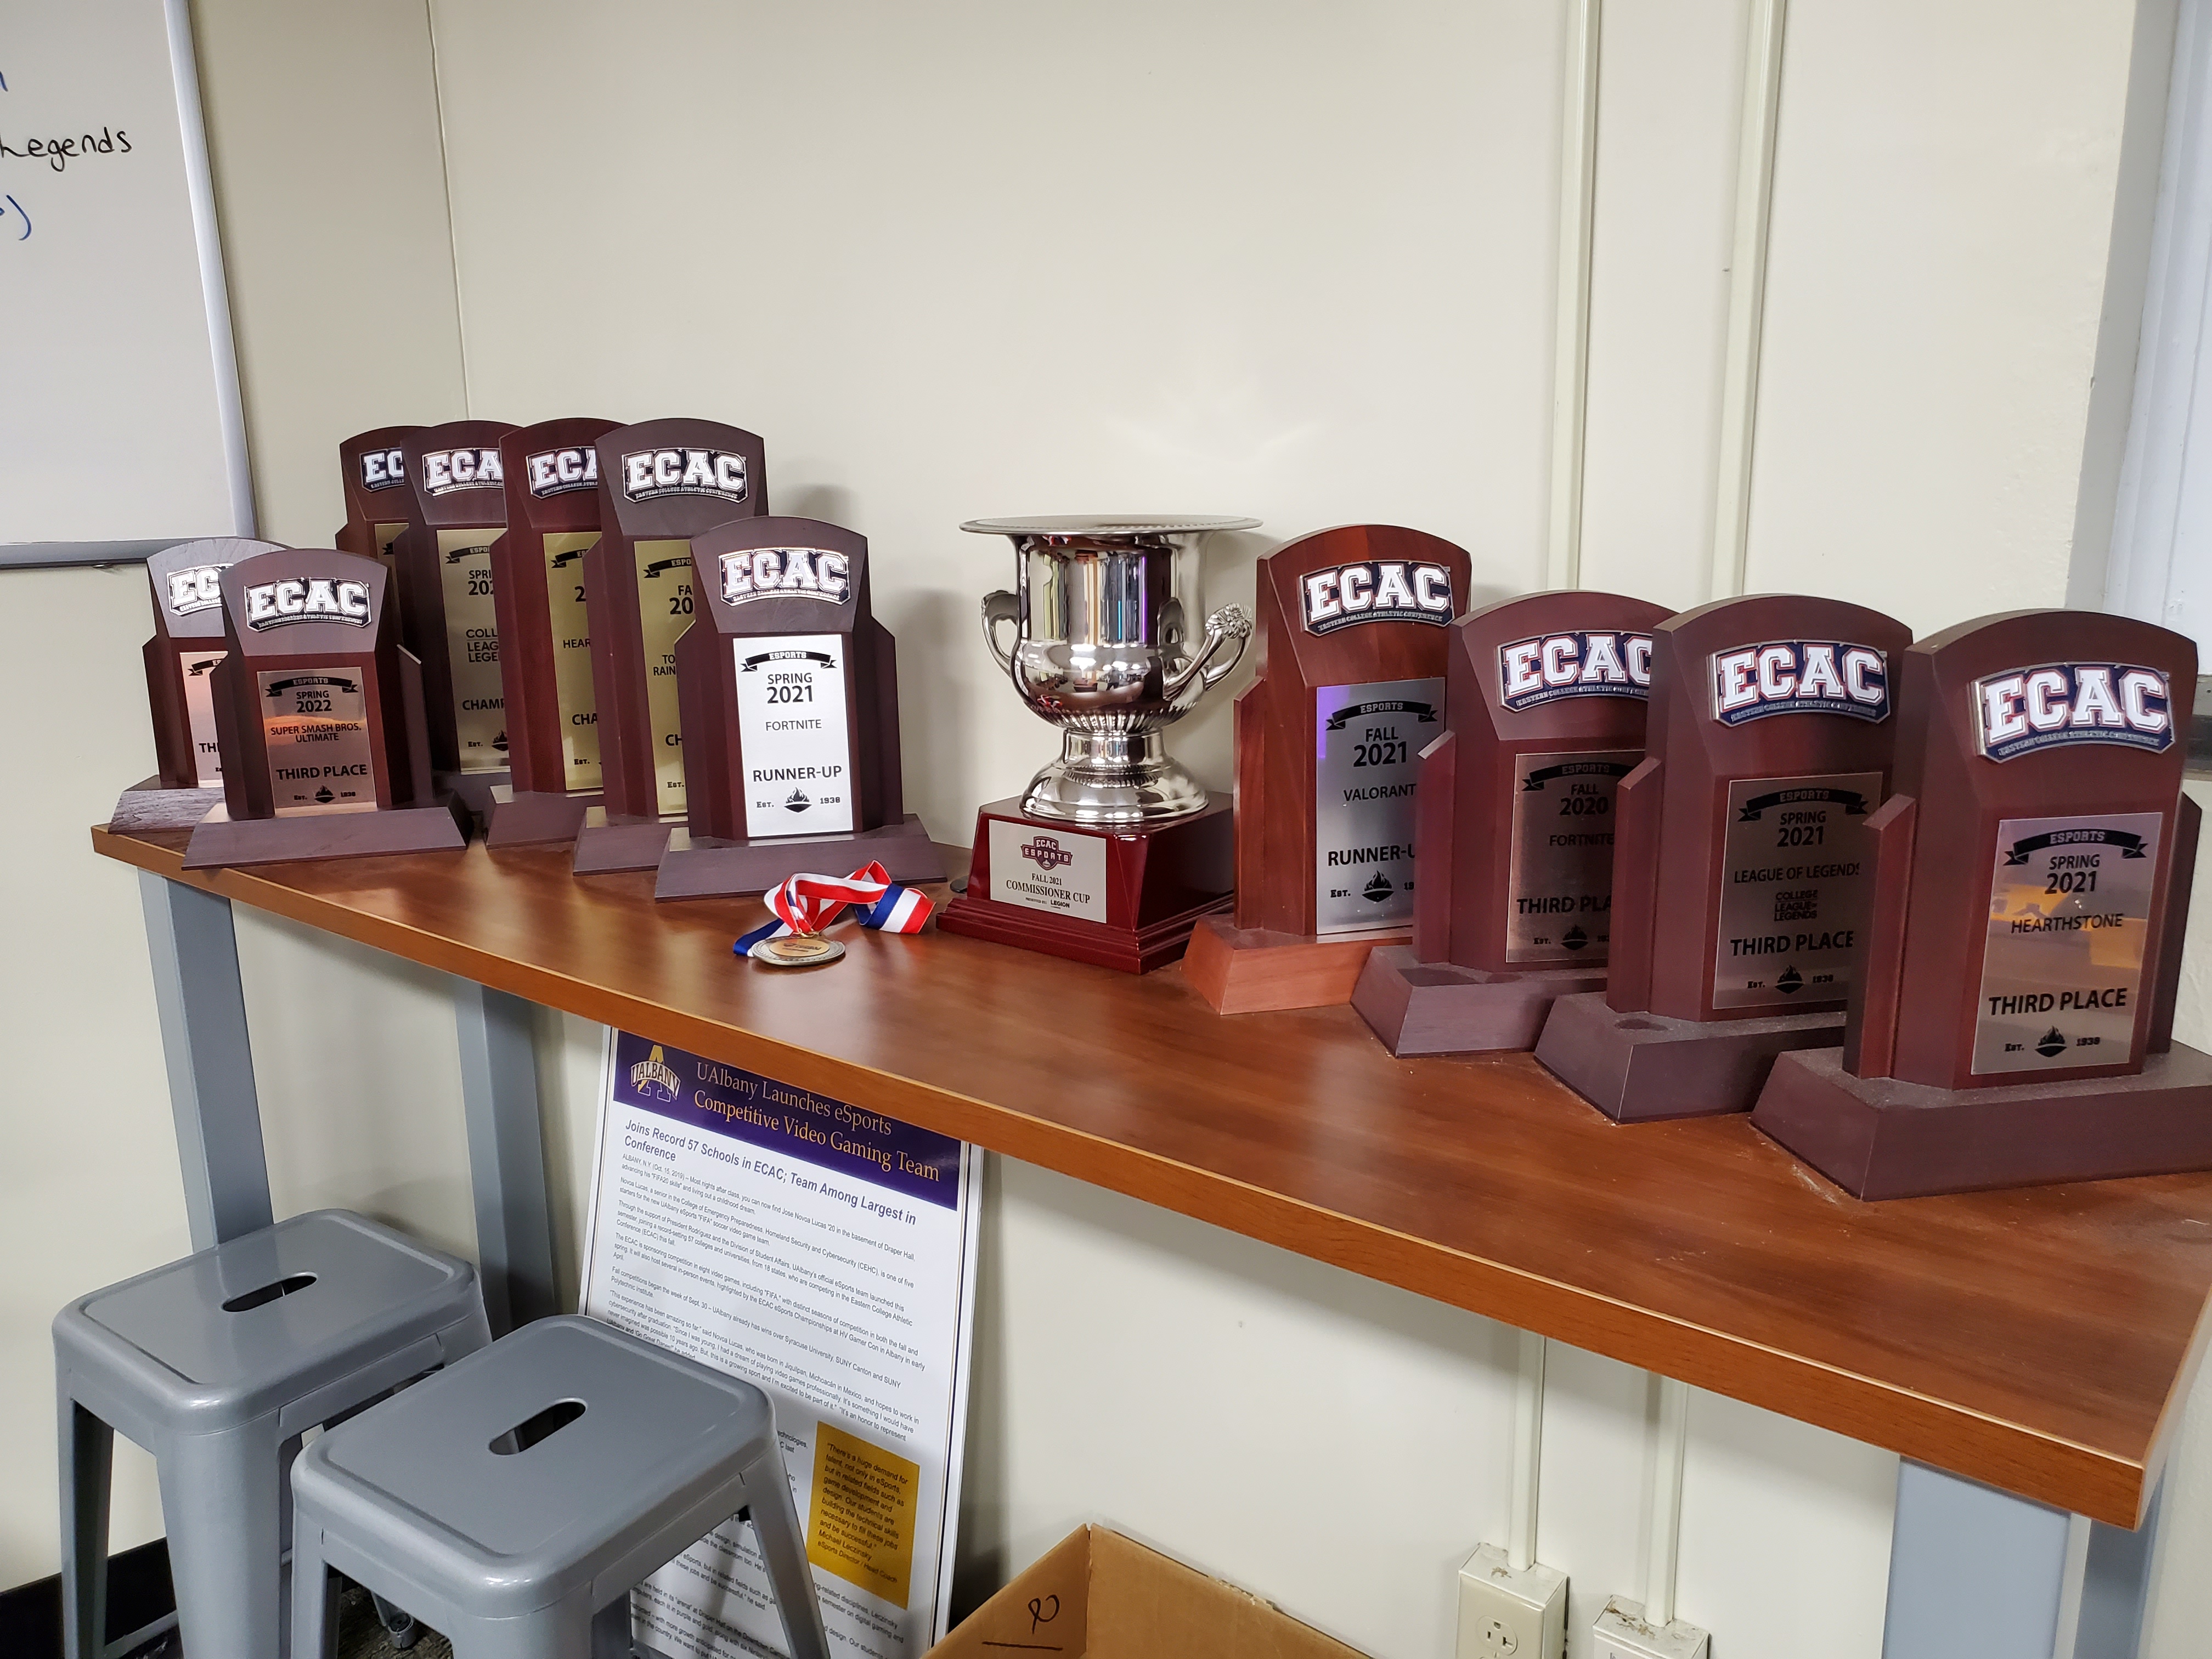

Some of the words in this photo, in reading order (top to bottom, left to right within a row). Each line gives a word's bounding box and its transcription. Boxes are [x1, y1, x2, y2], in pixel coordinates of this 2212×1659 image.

[627, 451, 744, 494] ECAC
[723, 550, 847, 597] ECAC
[248, 579, 368, 622] ECAC
[1306, 563, 1449, 624] ECAC
[769, 651, 807, 660] ESPORTS
[768, 672, 812, 685] SPRING
[1718, 644, 1886, 713] ECAC
[296, 691, 329, 700] SPRING
[766, 685, 813, 704] 2021
[296, 700, 332, 713] 2022
[1361, 702, 1403, 713] ESPORTS
[1983, 666, 2169, 747] ECAC
[270, 726, 300, 735] SUPER
[301, 724, 333, 733] SMASH
[335, 723, 362, 731] BROS.
[765, 719, 822, 731] FORTNITE
[295, 733, 339, 743] ULTIMATE
[1365, 726, 1398, 742] FALL
[1353, 741, 1407, 768] 2021
[276, 767, 320, 780] THIRD
[324, 764, 368, 777] PLACE
[753, 765, 842, 782] RUNNER-UP
[1562, 764, 1610, 775] ESPORTS
[1344, 783, 1417, 802] VALORANT
[1571, 783, 1599, 795] FALL
[1780, 790, 1829, 803] ESPORTS
[1559, 797, 1609, 816] 2020
[1780, 810, 1826, 825] SPRING
[1036, 839, 1057, 850] ECAC
[1549, 833, 1614, 847] FORTNITE
[1777, 826, 1824, 847] 2021
[2050, 831, 2106, 844] ESPORTS
[1025, 848, 1069, 862] ESPORTS
[2049, 854, 2100, 871] SPRING
[1031, 873, 1048, 883] FALL
[1049, 876, 1062, 886] 2021
[1734, 867, 1783, 884] LEAGUE
[1786, 866, 1803, 880] OF
[2045, 870, 2097, 894] 2021
[1006, 879, 1071, 900] COMMISSIONER
[1073, 892, 1090, 904] CUP
[1775, 889, 1818, 900] COLLEGE
[1050, 899, 1070, 909] LEGION
[1516, 896, 1576, 915] THIRD
[1775, 901, 1812, 912] LEAGUE
[1774, 910, 1818, 922] LEGENDS
[2011, 913, 2124, 934] HEARTHSTONE
[1730, 935, 1791, 956] THIRD
[1795, 930, 1854, 952] PLACE
[1989, 992, 2054, 1015] THIRD
[2059, 988, 2128, 1011] PLACE
[631, 1061, 681, 1101] UALBANY
[697, 1061, 758, 1101] UAlbany
[762, 1081, 831, 1117] Launches
[834, 1104, 892, 1136] eSports
[695, 1090, 779, 1131] Competitive
[783, 1115, 826, 1145] Video
[830, 1131, 892, 1172] Gaming
[896, 1150, 940, 1182] Team
[624, 1136, 676, 1162] Conference
[625, 1119, 650, 1136] Joins
[652, 1127, 686, 1148] Record
[687, 1139, 699, 1152] 57
[701, 1143, 740, 1165] Schools
[742, 1156, 751, 1169] in
[754, 1160, 787, 1184] ECAC;
[791, 1172, 818, 1192] Team
[819, 1183, 858, 1207] Among
[861, 1196, 903, 1221] Largest
[905, 1210, 916, 1225] in
[622, 1153, 641, 1165] ALBANY,
[652, 1164, 663, 1172] (Oct.
[672, 1170, 685, 1181] 2019)
[690, 1176, 701, 1186] Most
[701, 1181, 715, 1190] nights
[716, 1186, 726, 1194] after
[727, 1190, 741, 1200] class,
[772, 1204, 781, 1213] find
[782, 1208, 794, 1217] Jose
[794, 1212, 810, 1223] Novoa
[811, 1218, 826, 1229] Lucas
[842, 1229, 850, 1237] the
[851, 1232, 877, 1247] basement
[884, 1243, 902, 1256] Draper
[903, 1250, 915, 1262] Hall,
